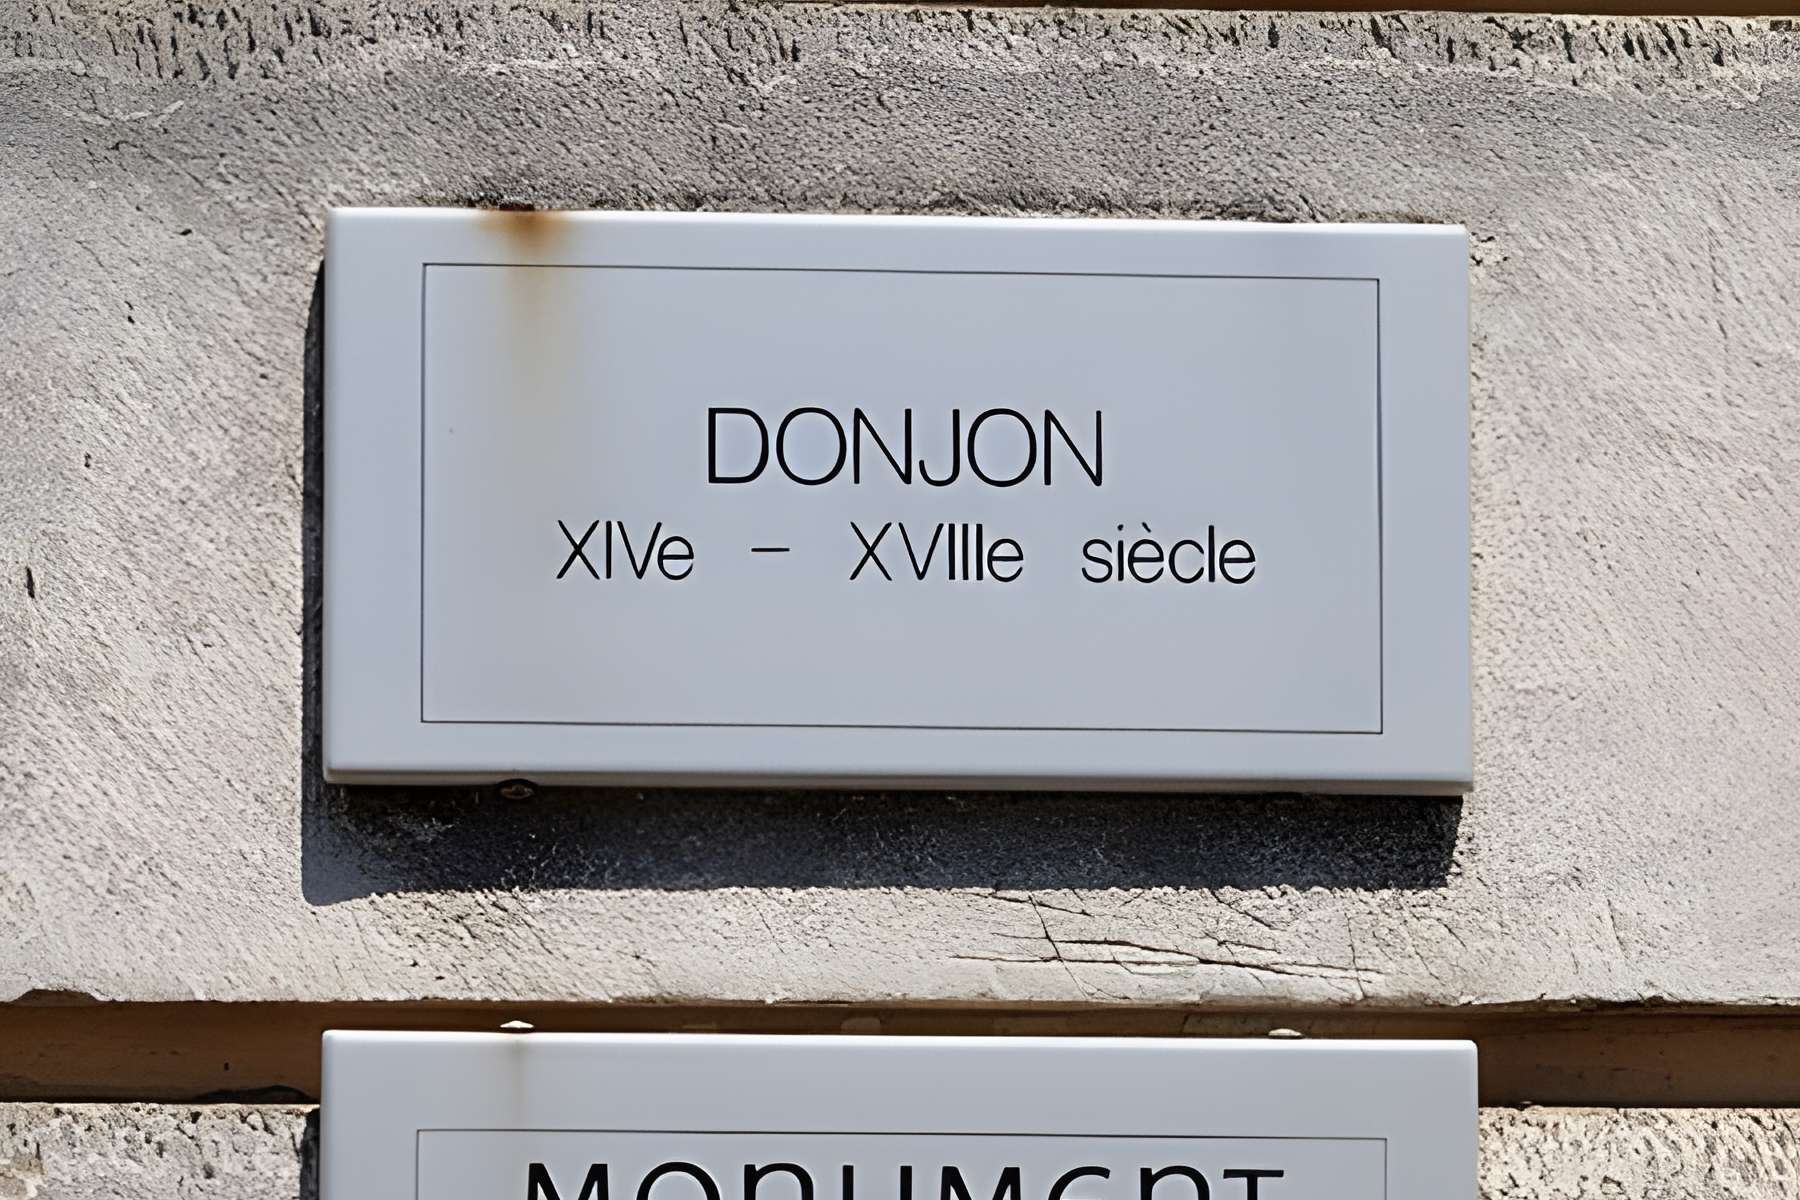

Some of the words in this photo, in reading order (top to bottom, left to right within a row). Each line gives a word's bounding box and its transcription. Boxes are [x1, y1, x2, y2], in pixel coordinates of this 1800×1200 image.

[706, 405, 1103, 488] DONJON
[556, 519, 696, 582] XIVe
[848, 521, 1024, 583] XVIIIe
[1081, 519, 1257, 585] siècle
